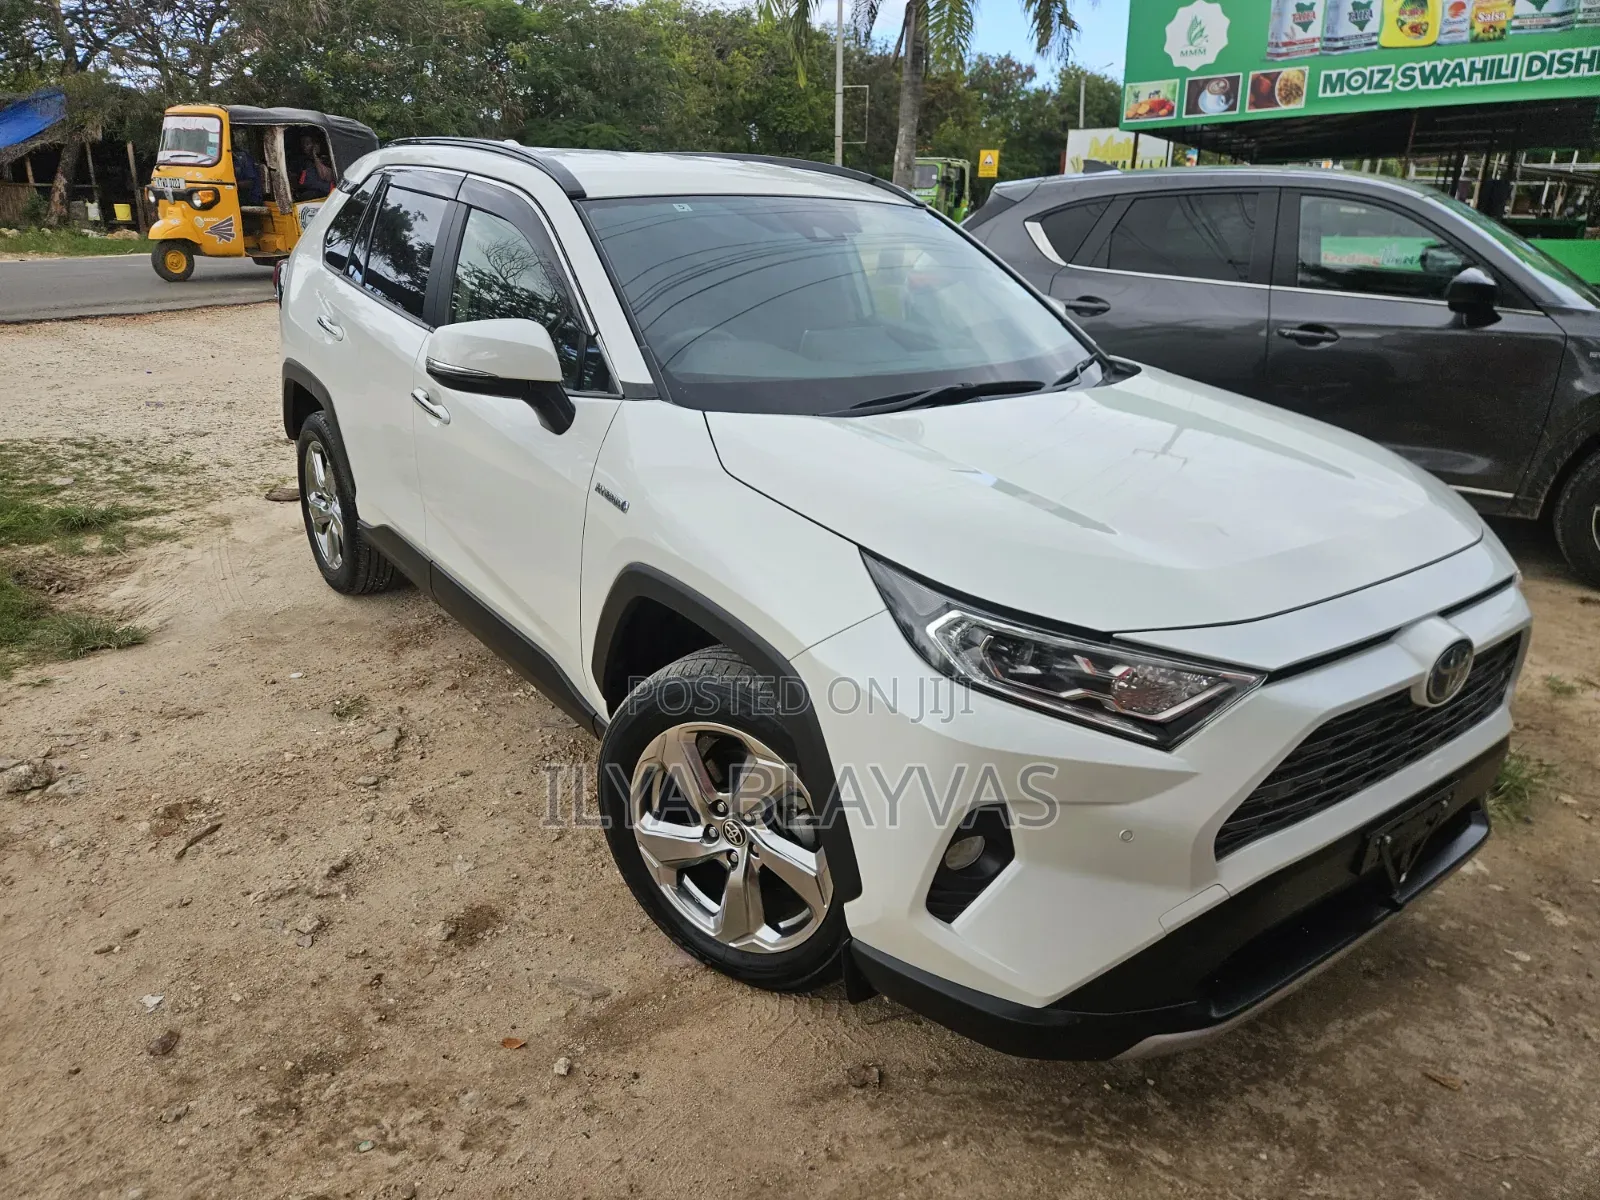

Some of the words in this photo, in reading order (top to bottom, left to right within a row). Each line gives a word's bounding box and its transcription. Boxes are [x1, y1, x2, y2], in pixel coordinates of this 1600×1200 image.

[1477, 10, 1506, 23] Salsa
[1319, 64, 1396, 97] MOIZ
[1397, 53, 1523, 91] SWAHILI
